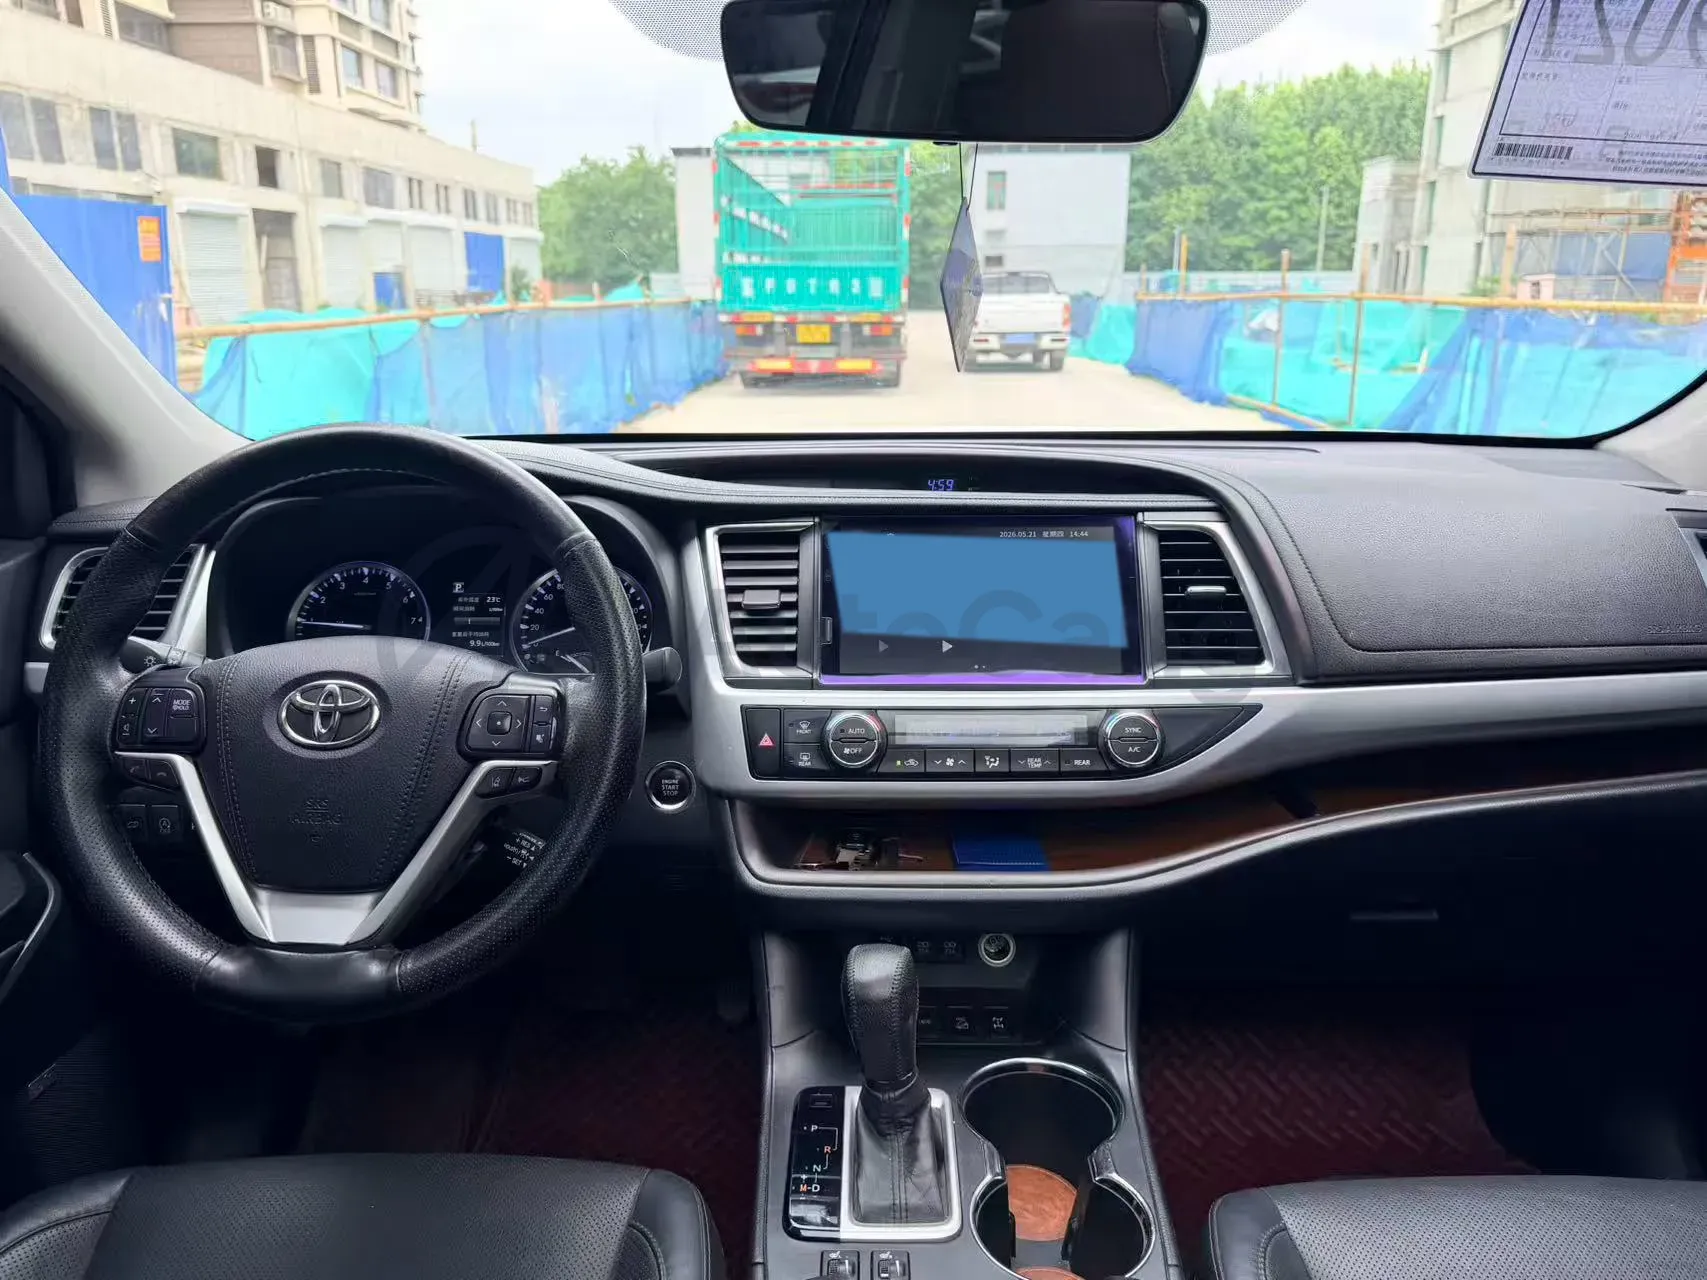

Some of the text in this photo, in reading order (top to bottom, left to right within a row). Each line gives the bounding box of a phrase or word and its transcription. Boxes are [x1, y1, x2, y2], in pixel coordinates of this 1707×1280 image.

[928, 479, 954, 491] 4:59
[340, 582, 346, 590] 3
[386, 582, 392, 590] 5
[320, 596, 326, 604] 2
